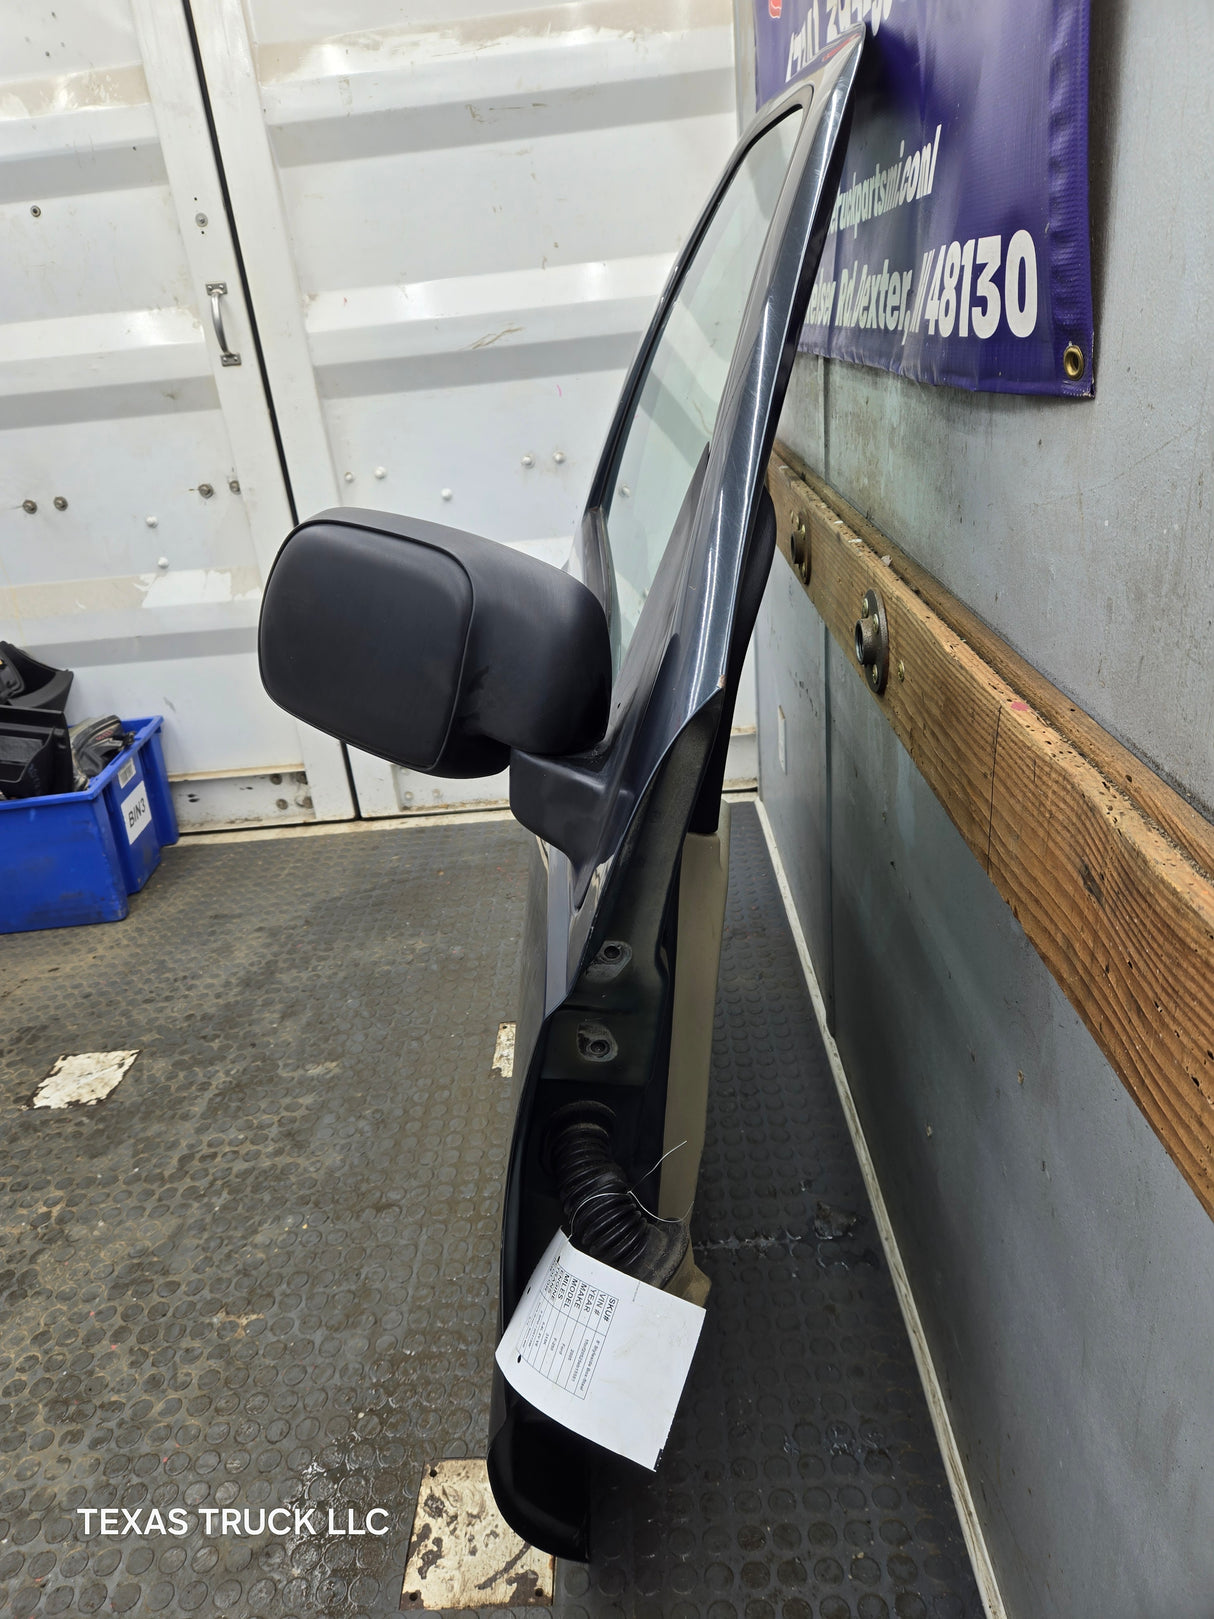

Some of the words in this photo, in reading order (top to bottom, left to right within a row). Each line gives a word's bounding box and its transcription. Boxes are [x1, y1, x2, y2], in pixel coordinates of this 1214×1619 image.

[924, 229, 1038, 339] 48130
[558, 1273, 570, 1300] MILES
[564, 1278, 578, 1308] MODEL
[574, 1283, 588, 1309] MAKE
[584, 1289, 597, 1313] YEAR
[596, 1293, 606, 1309] VIN
[603, 1297, 616, 1322] SKU#
